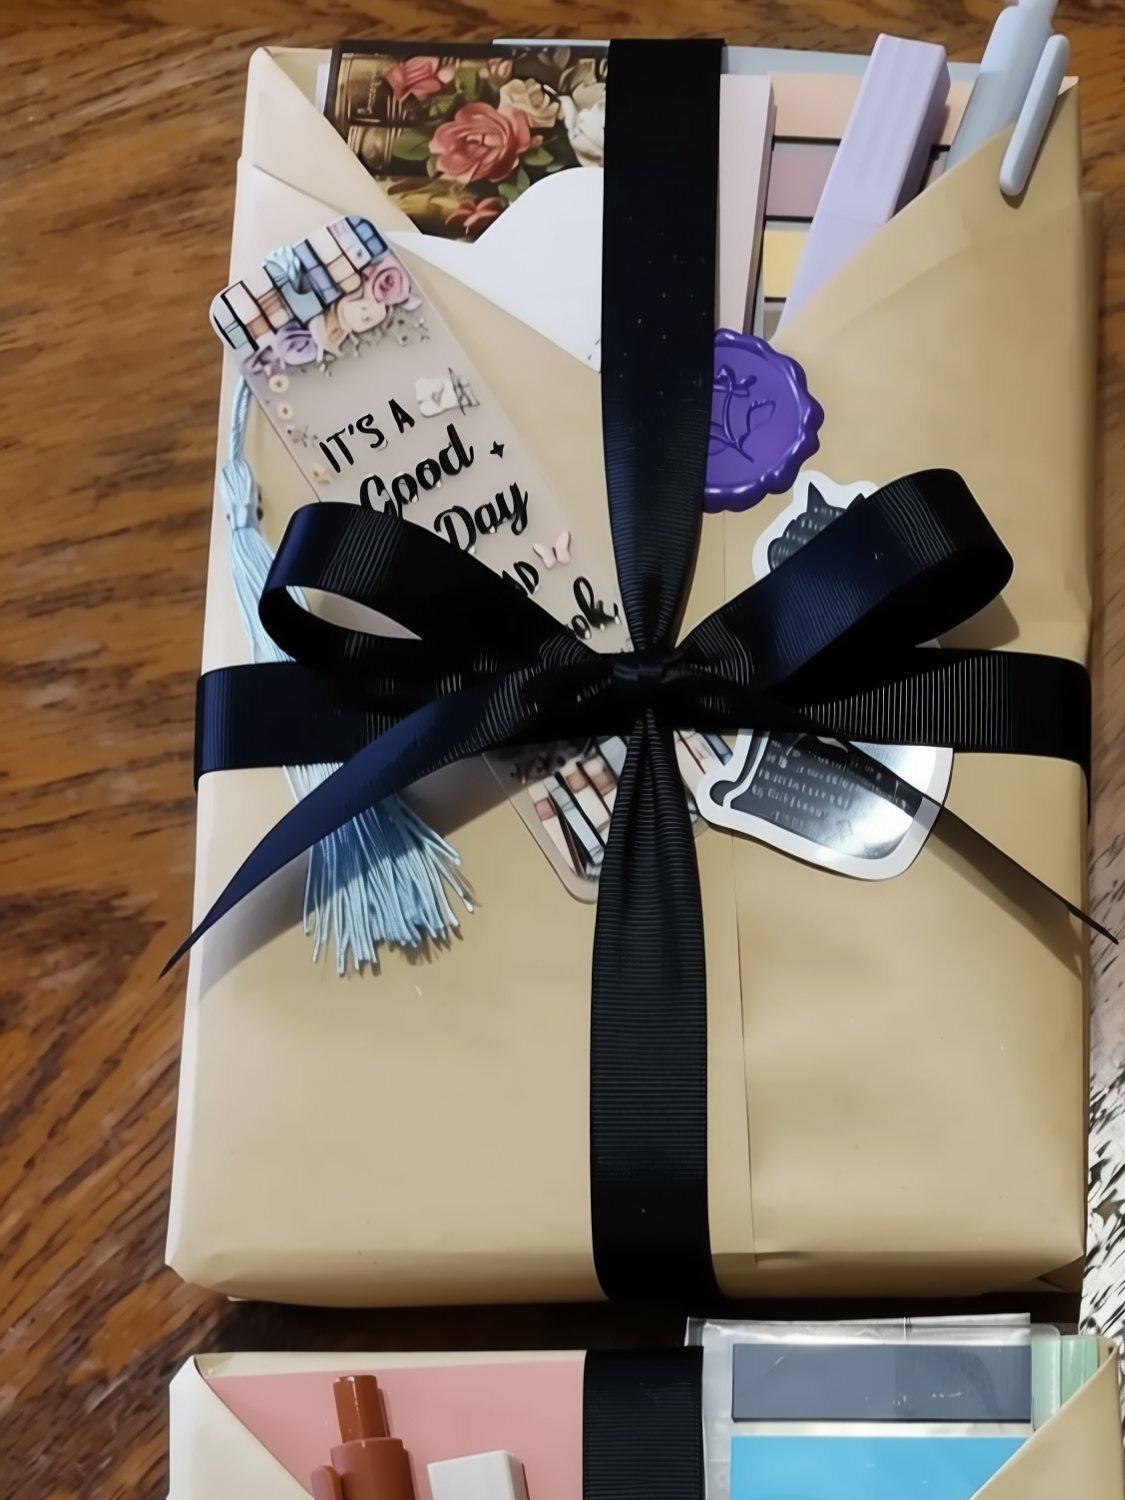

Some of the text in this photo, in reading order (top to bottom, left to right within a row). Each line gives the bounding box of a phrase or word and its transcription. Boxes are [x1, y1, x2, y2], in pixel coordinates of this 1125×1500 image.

[319, 398, 415, 473] IT'S A
[359, 422, 475, 521] Good
[433, 481, 529, 552] Day
